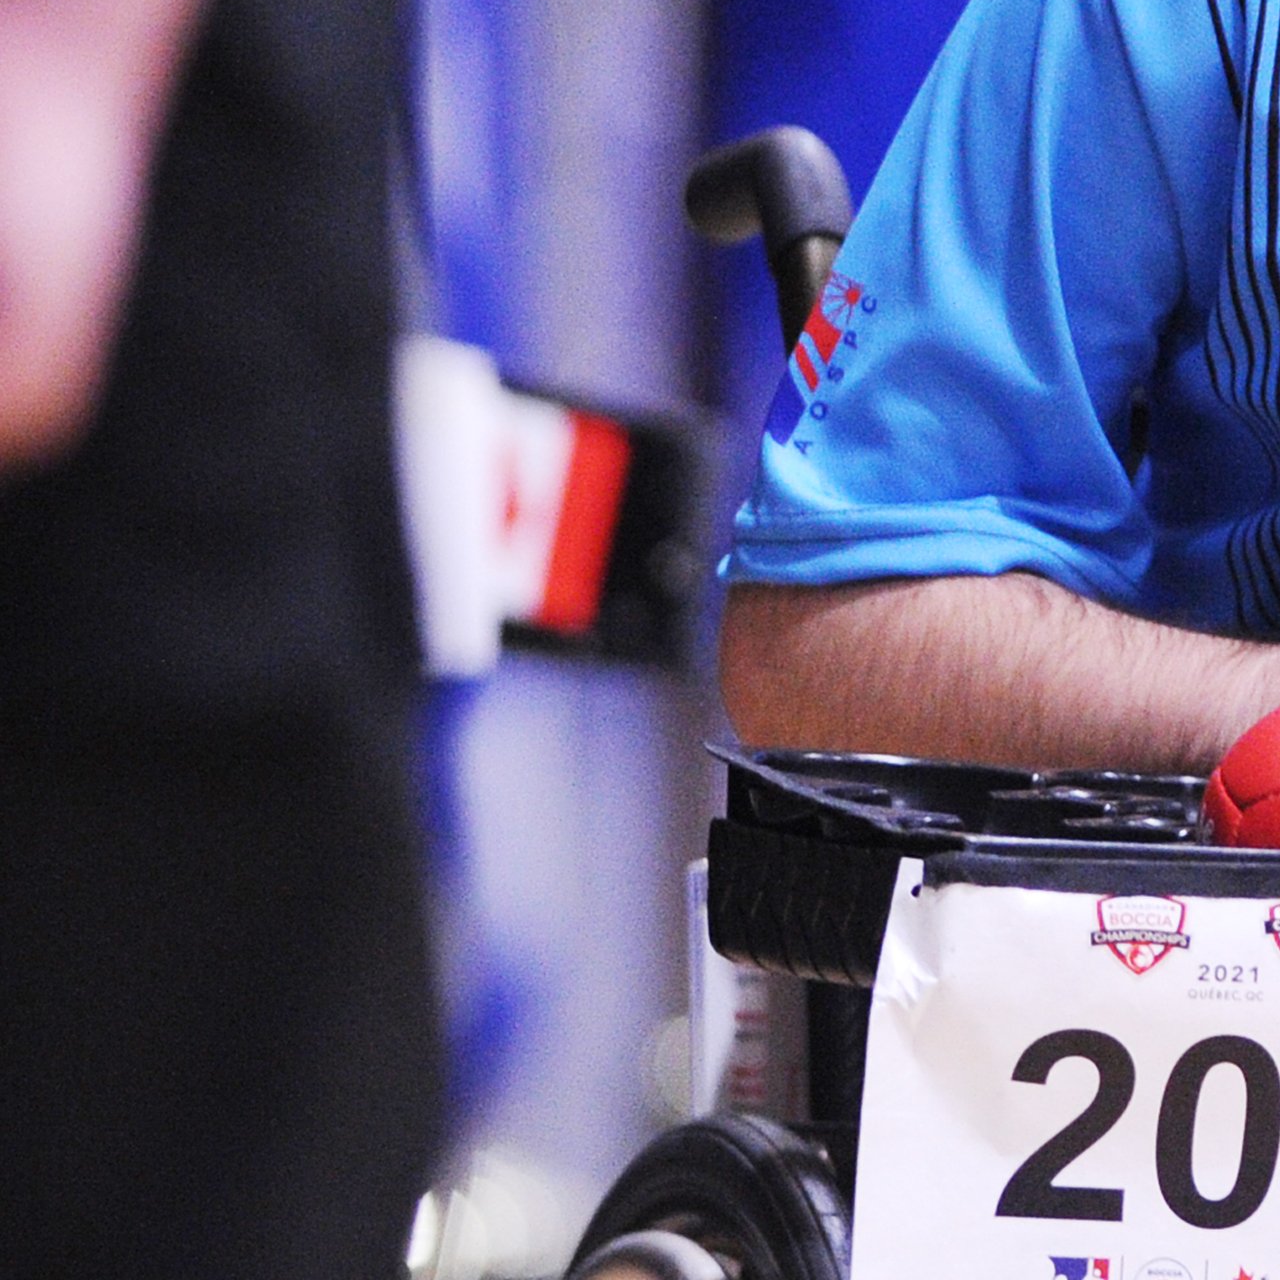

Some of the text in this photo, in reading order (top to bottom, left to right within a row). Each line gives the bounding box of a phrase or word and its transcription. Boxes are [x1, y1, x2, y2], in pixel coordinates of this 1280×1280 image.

[1109, 912, 1173, 928] BOCCIA
[1094, 930, 1188, 947] CHAMPIONSHIPS
[1197, 964, 1260, 983] 2021
[1245, 989, 1264, 1002] QC
